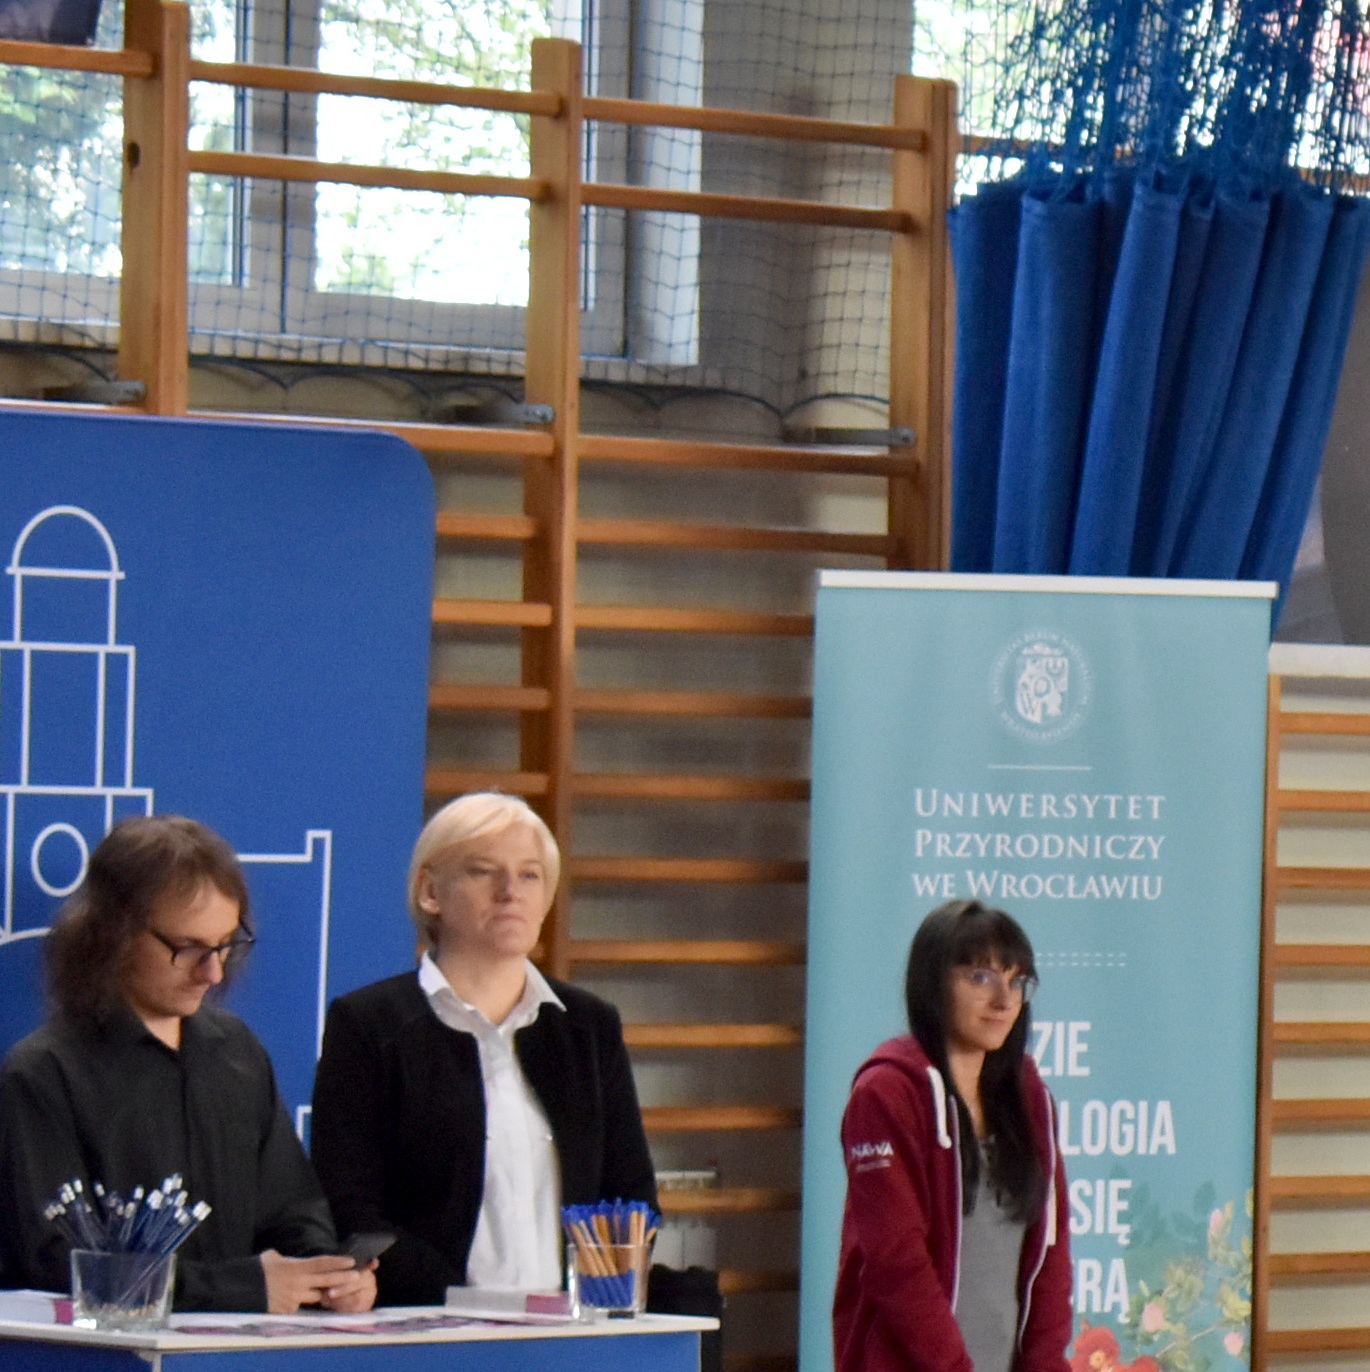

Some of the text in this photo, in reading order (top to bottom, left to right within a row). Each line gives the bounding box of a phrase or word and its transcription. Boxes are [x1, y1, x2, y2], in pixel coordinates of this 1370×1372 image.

[914, 788, 1166, 820] UNIWERSYTET
[914, 828, 1166, 861] PRZYRODNICZY
[912, 869, 1164, 900] WE WROCŁAWIU
[1031, 1021, 1092, 1077] ZIE
[1058, 1099, 1177, 1156] LOGIA
[1069, 1179, 1132, 1245] SIĘ
[1070, 1258, 1131, 1324] RĄ
